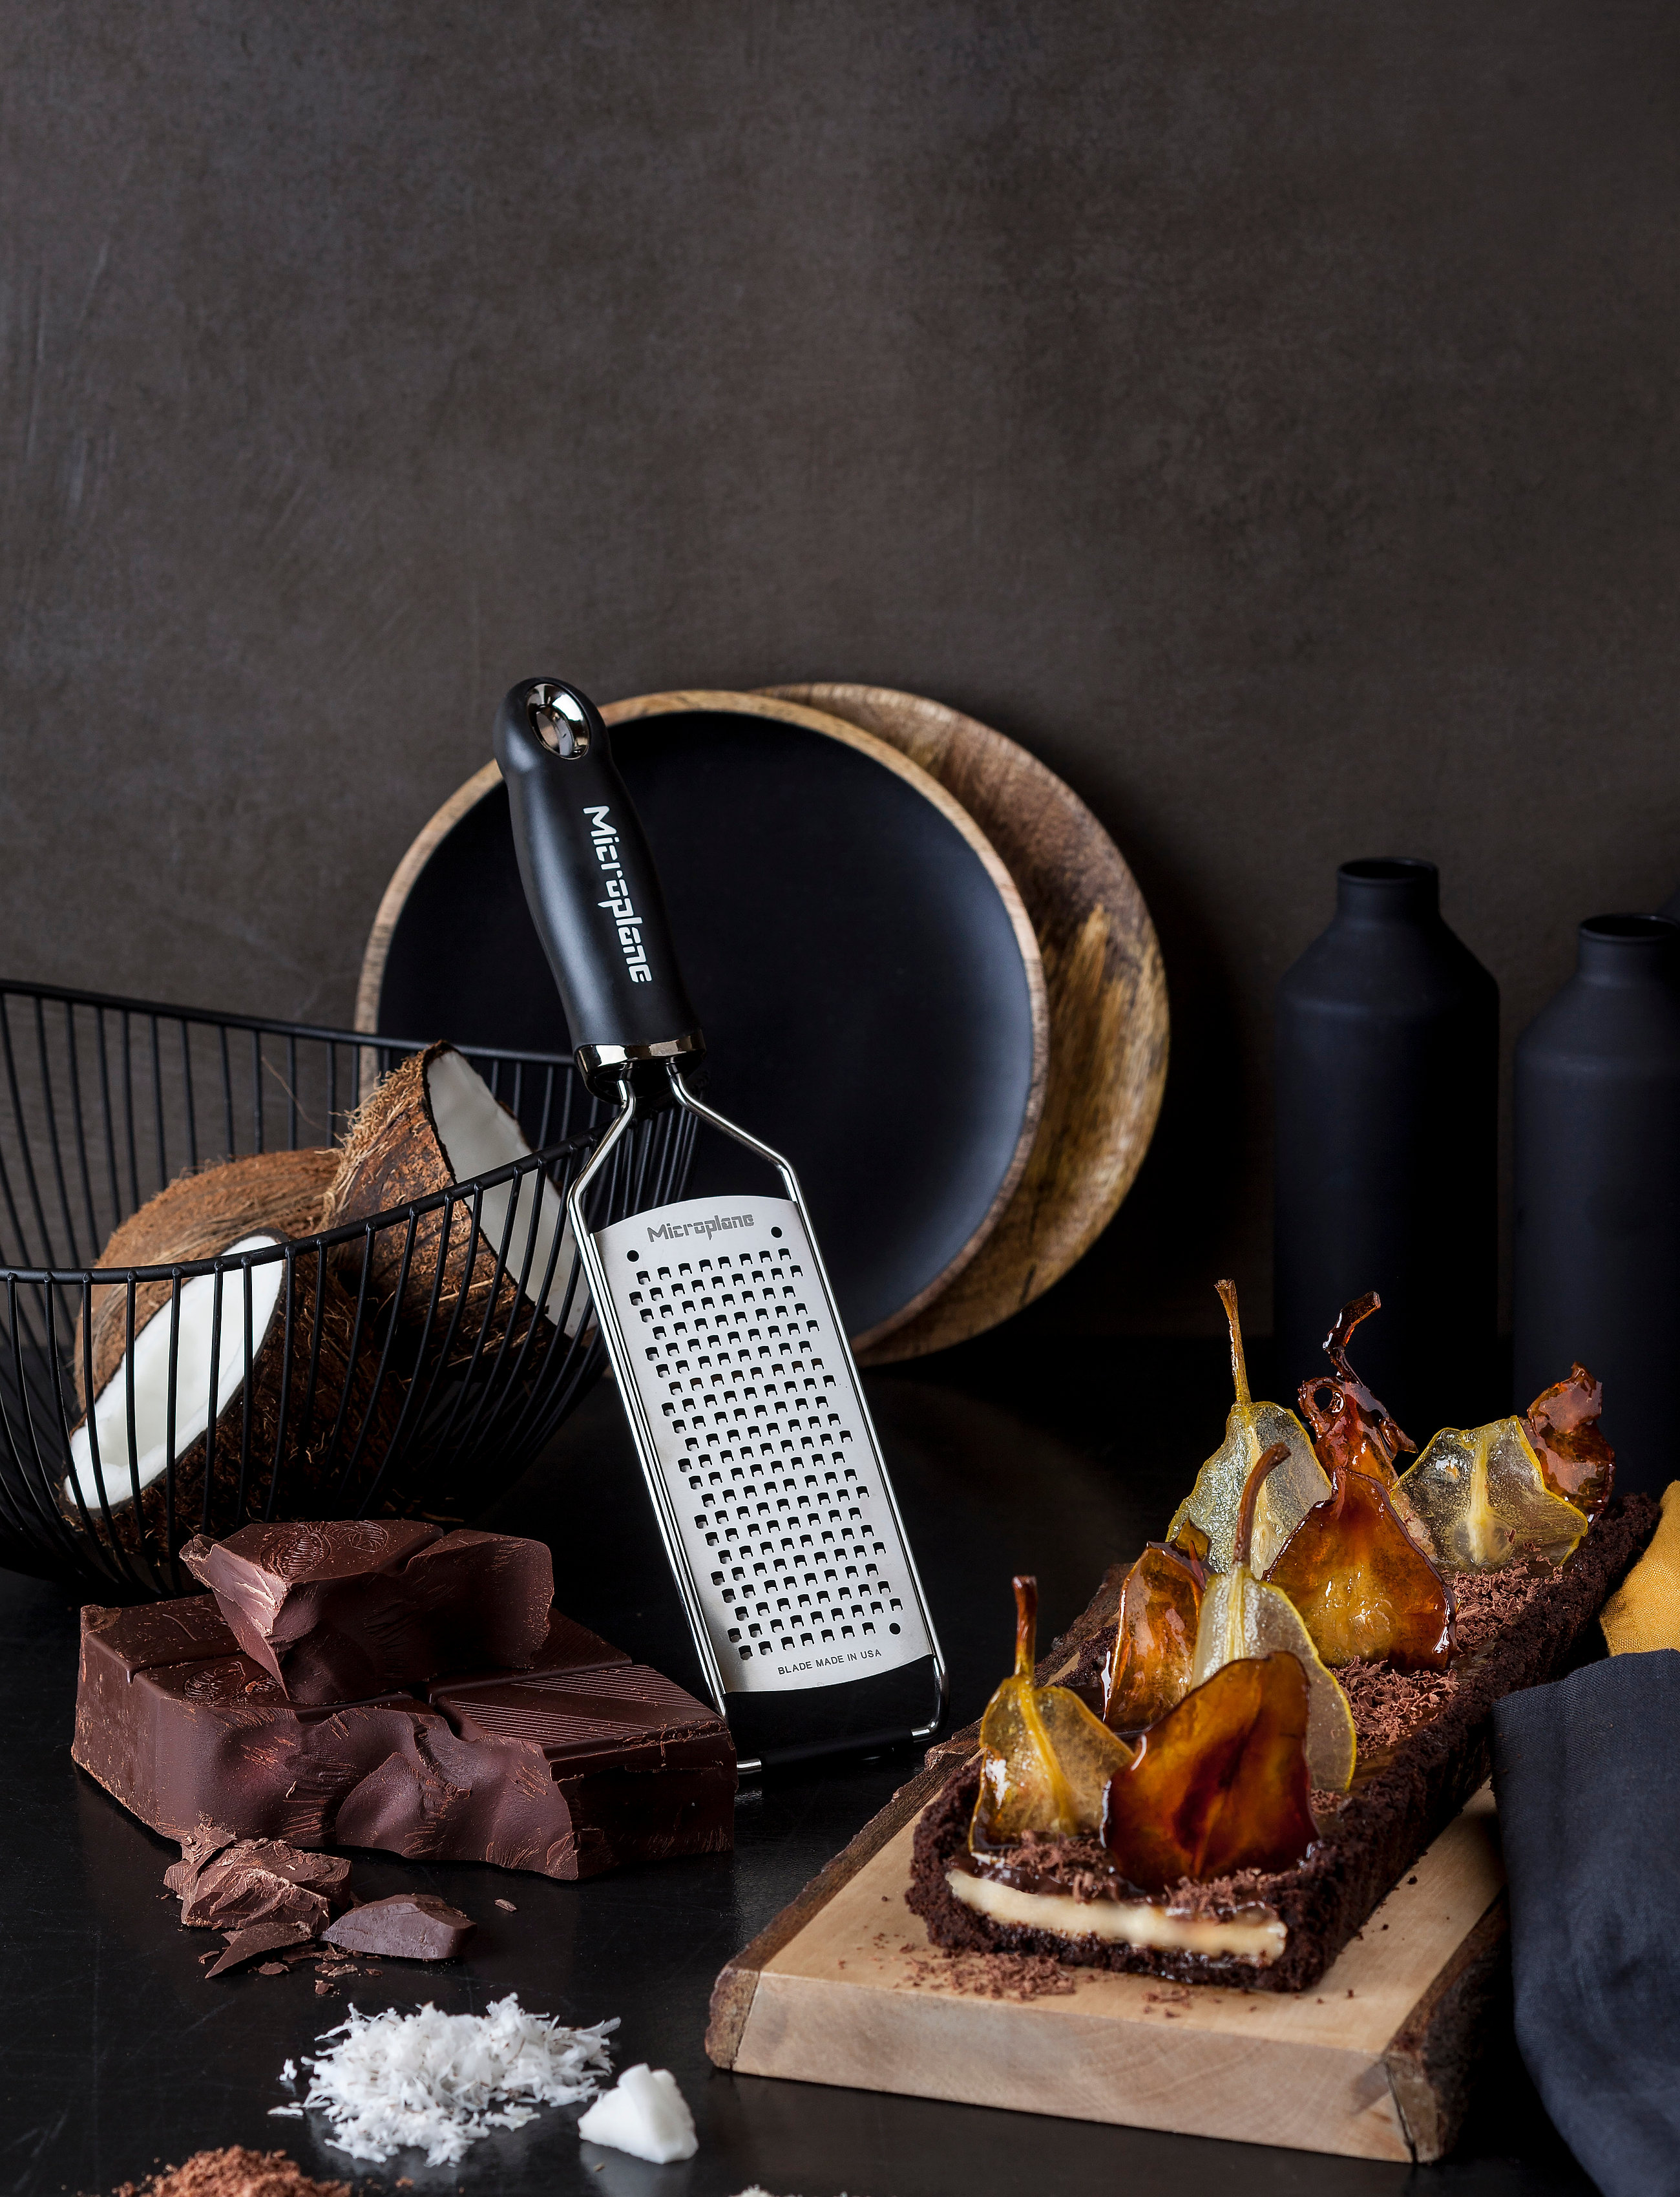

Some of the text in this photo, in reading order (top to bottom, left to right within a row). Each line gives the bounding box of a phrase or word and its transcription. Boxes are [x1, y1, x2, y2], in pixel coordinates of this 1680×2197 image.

[583, 805, 652, 983] Microplane
[647, 1214, 755, 1243] Microplane
[777, 1648, 882, 1675] BLADE MADE IN USA
